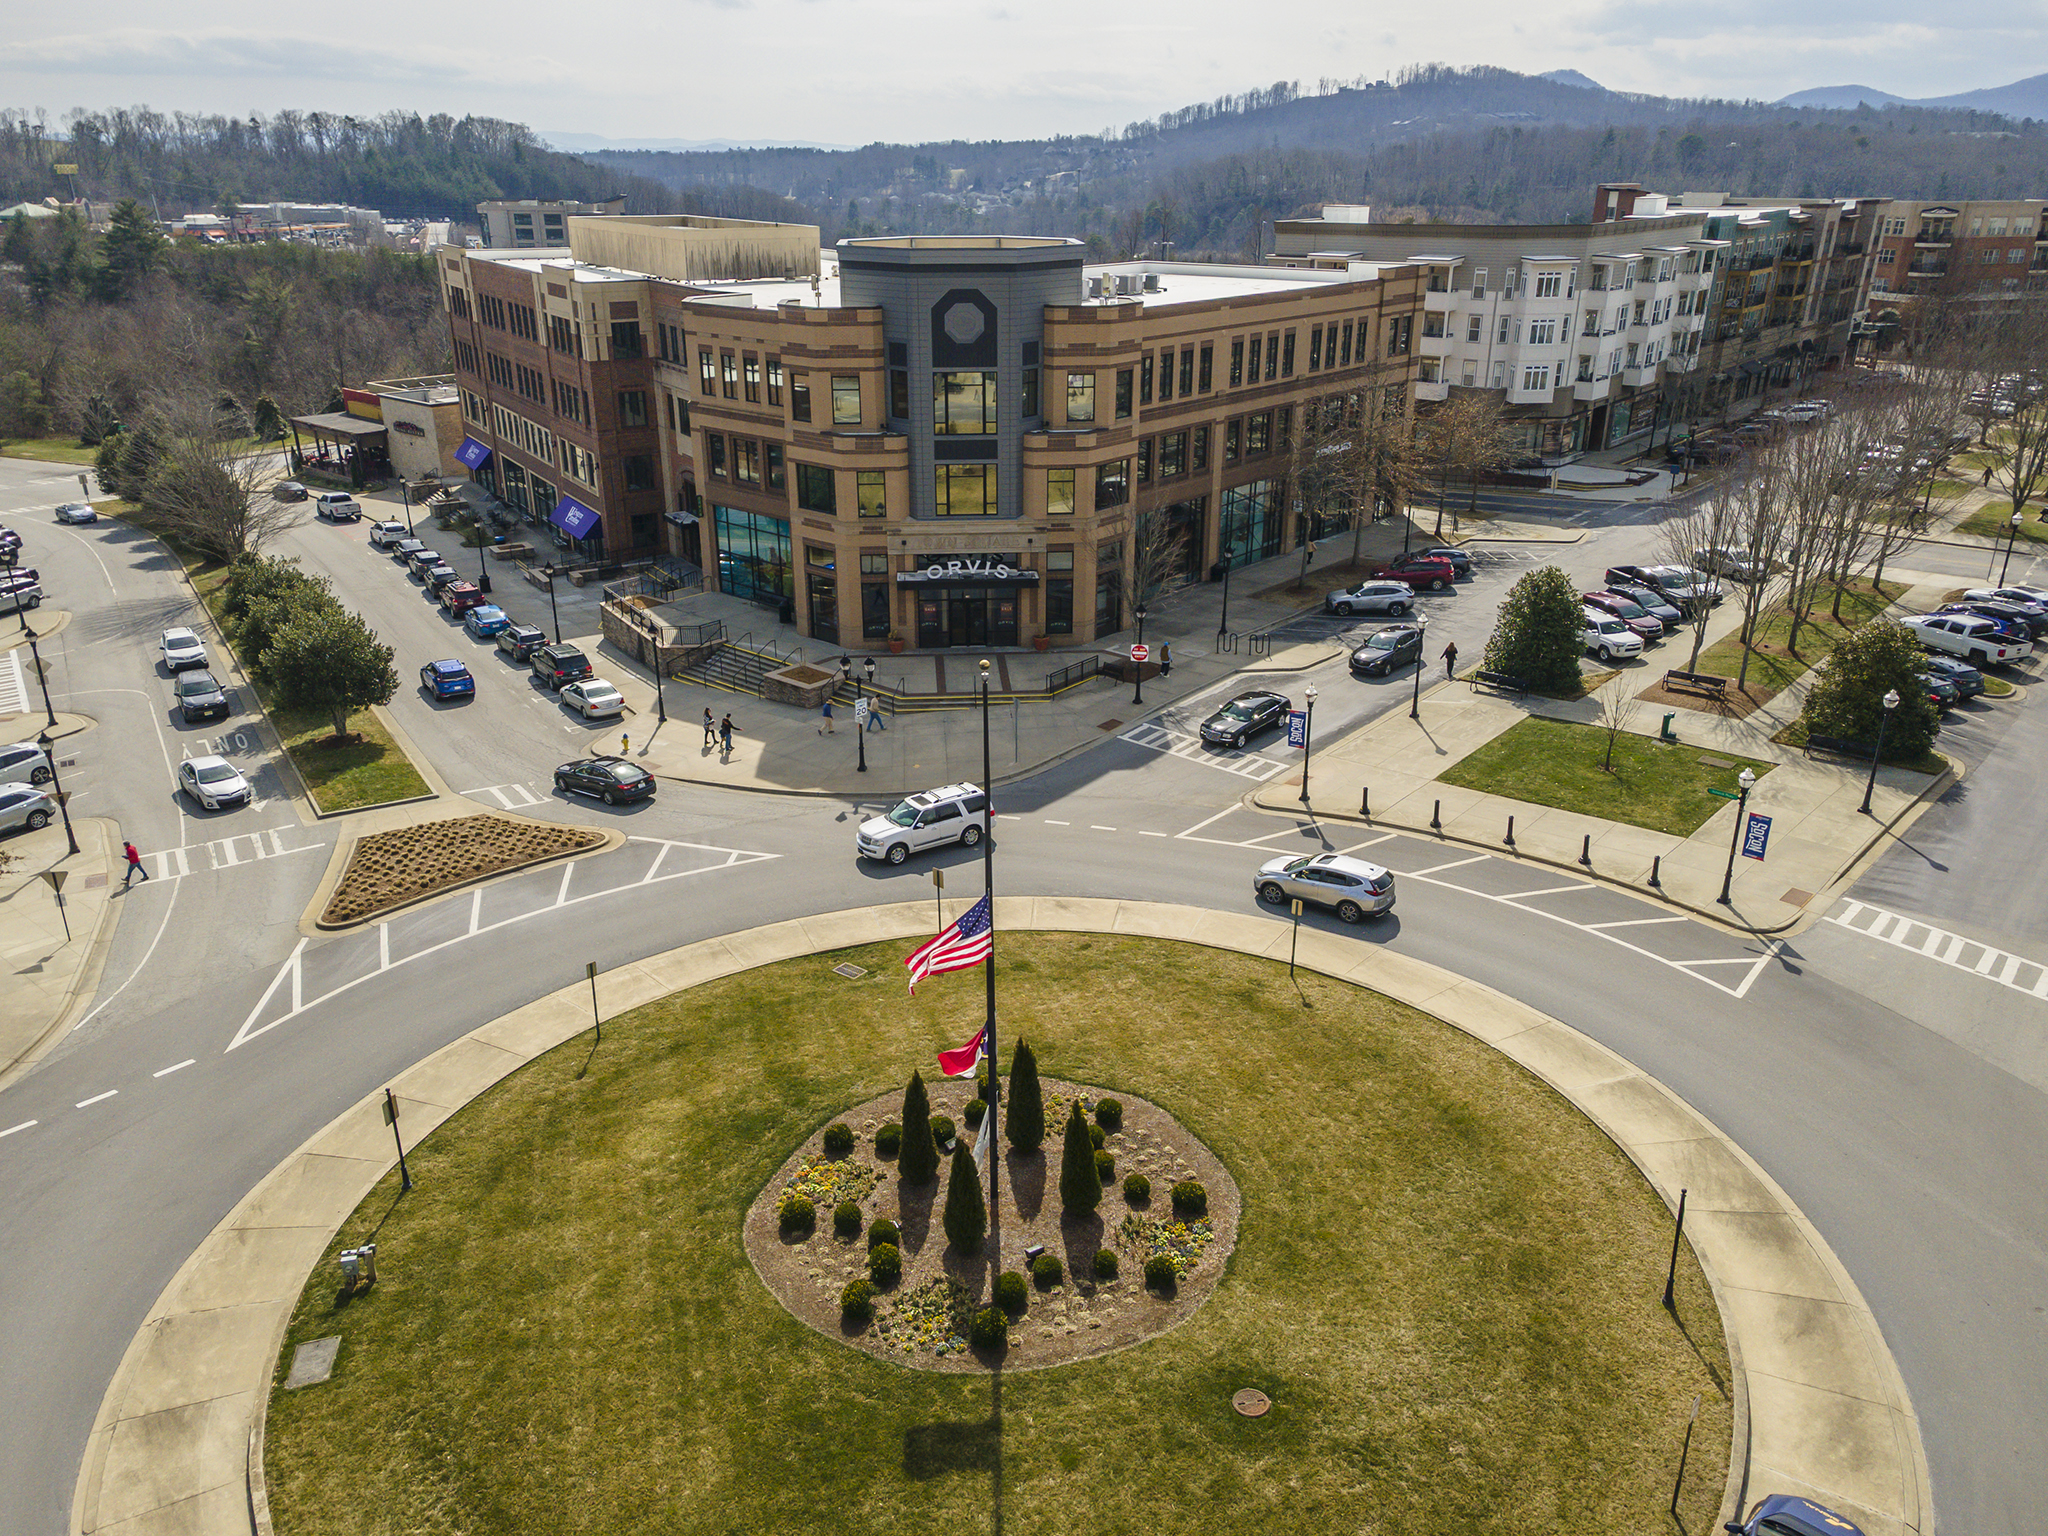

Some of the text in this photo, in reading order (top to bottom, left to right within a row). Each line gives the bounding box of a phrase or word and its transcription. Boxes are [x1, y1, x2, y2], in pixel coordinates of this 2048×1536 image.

[915, 535, 957, 548] OWN
[927, 559, 1009, 579] ORVIS
[856, 707, 867, 716] 20
[181, 733, 248, 760] ONLY
